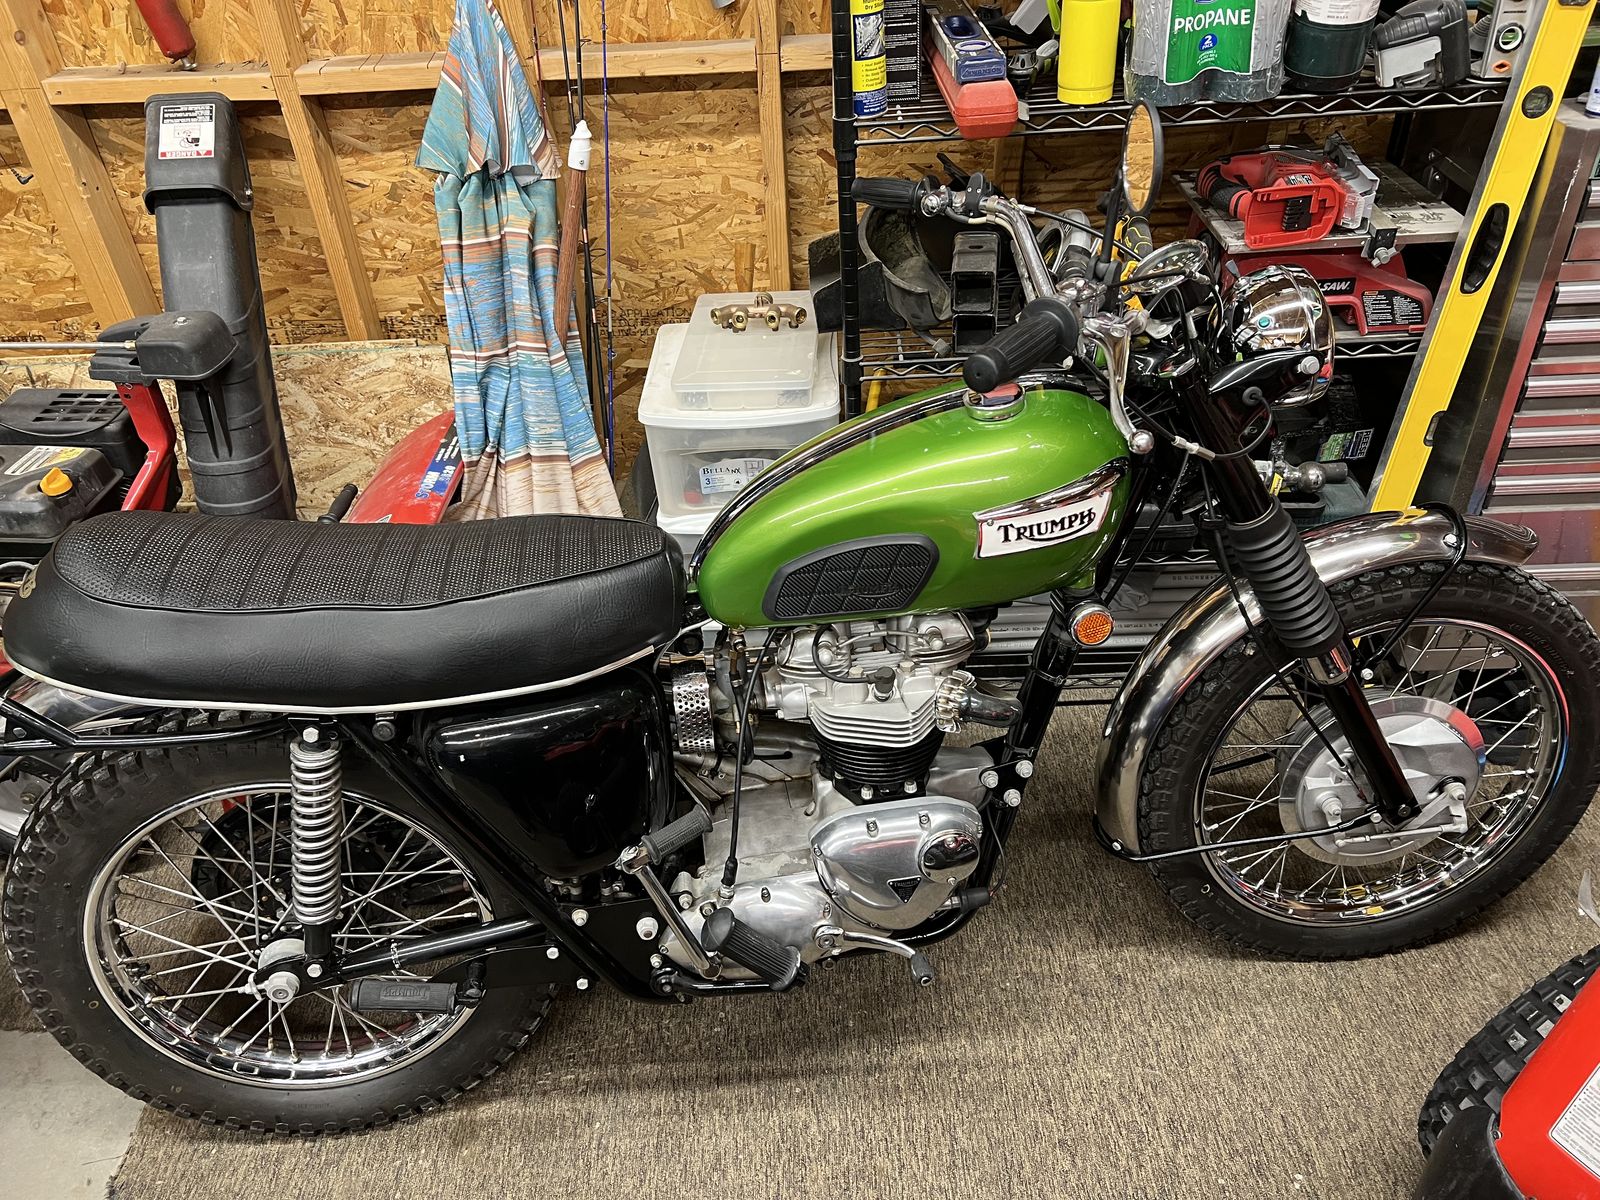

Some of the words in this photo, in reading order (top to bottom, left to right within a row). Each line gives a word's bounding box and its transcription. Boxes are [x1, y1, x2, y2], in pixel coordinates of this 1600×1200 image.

[1174, 8, 1251, 34] PROPANE
[1204, 35, 1213, 45] 2
[622, 307, 692, 318] APPLICATION
[415, 471, 440, 498] STORM
[705, 478, 711, 486] 3
[997, 507, 1096, 543] TRIUMPH
